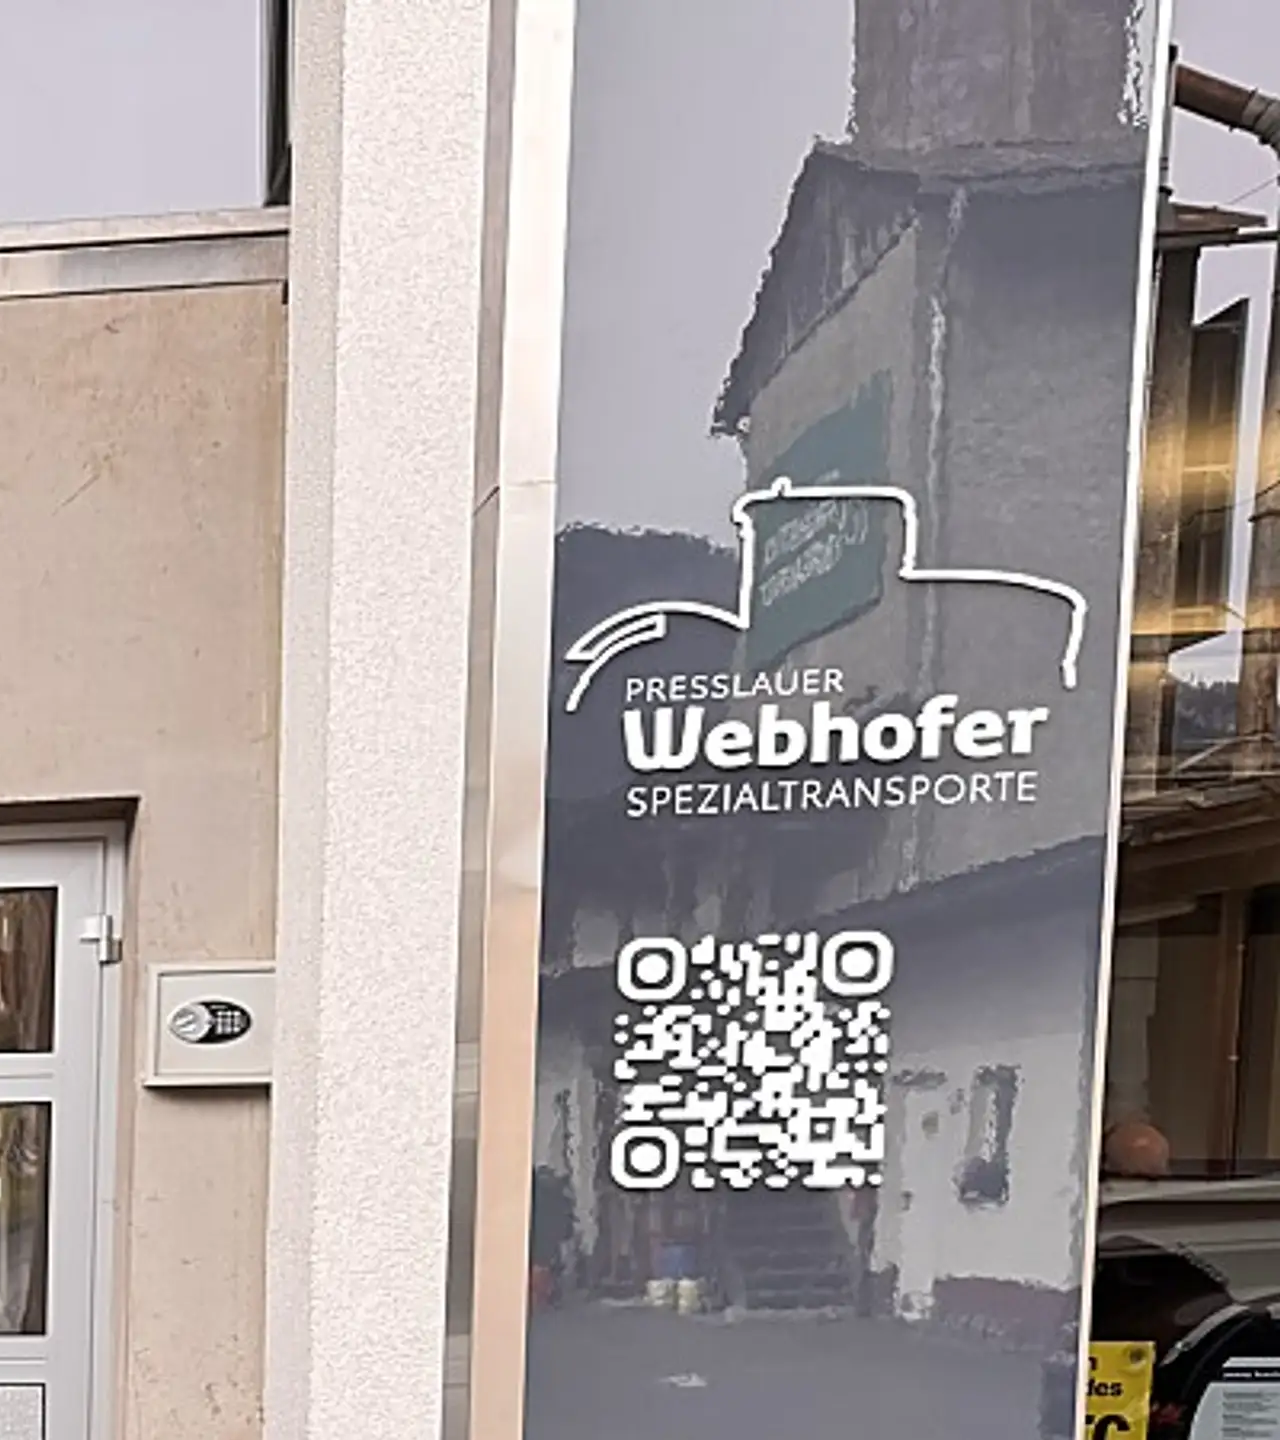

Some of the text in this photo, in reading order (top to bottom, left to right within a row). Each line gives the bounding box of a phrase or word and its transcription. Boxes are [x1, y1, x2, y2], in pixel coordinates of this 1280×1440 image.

[625, 667, 845, 703] PRESSLAUER
[621, 695, 1048, 771] Webhofer
[625, 771, 1039, 817] SPEZIALTRANSPORTE
